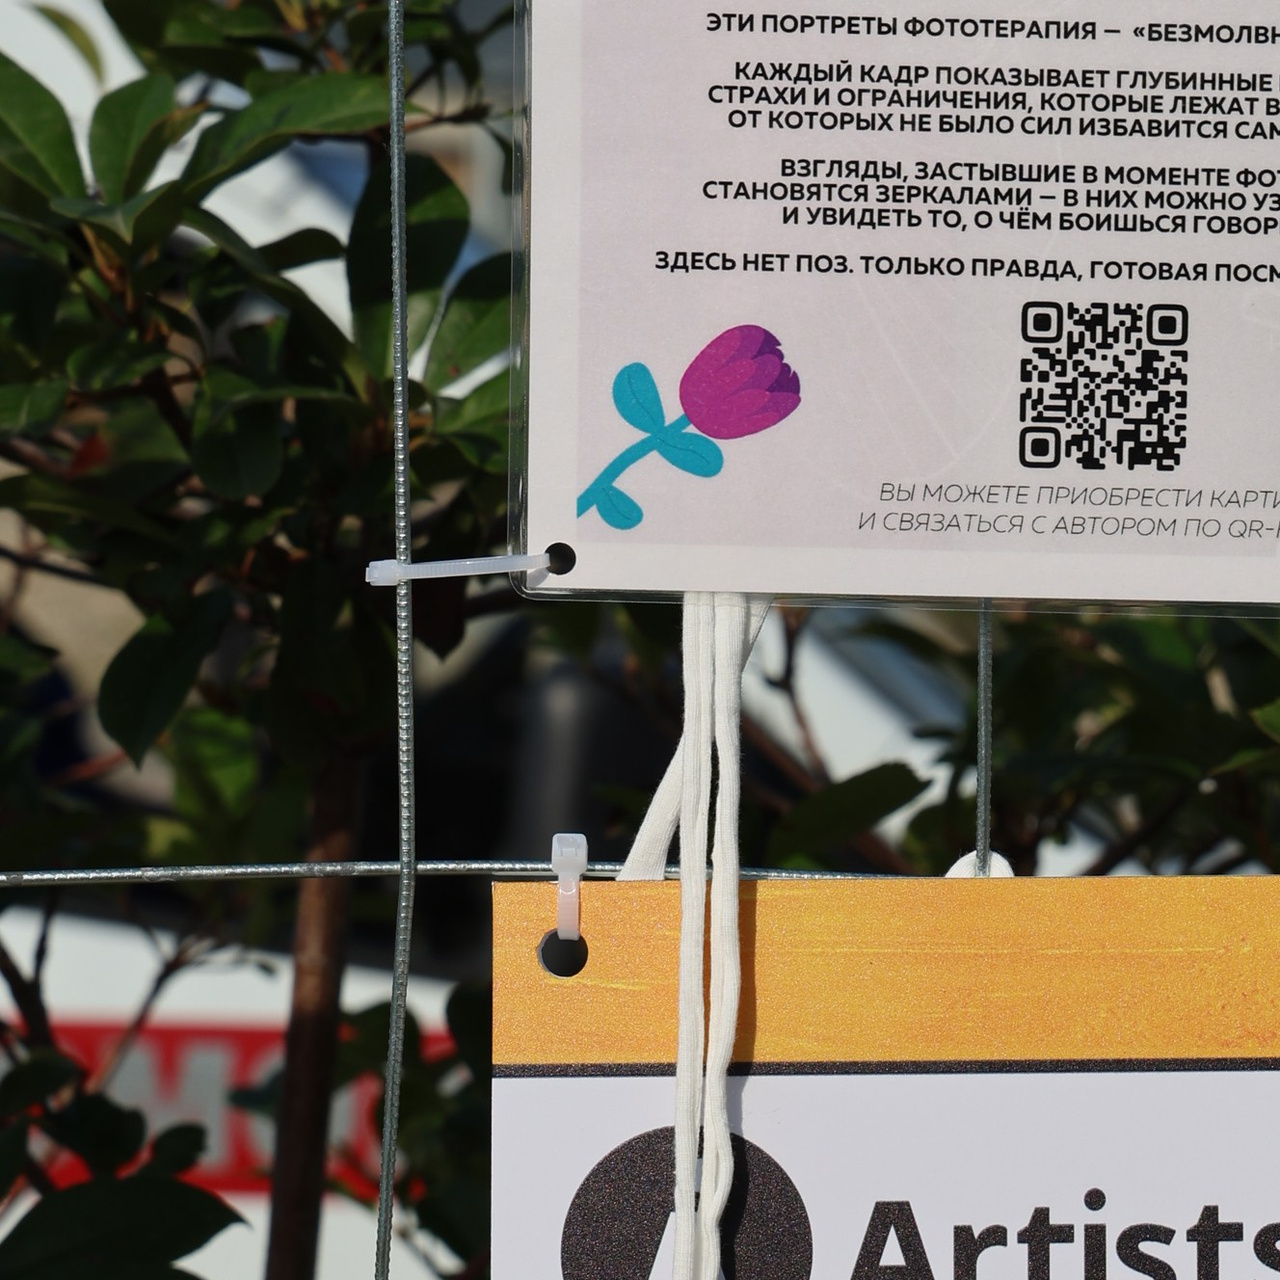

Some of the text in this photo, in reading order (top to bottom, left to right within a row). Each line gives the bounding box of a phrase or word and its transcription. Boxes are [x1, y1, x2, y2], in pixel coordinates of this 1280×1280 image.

[706, 12, 755, 32] ЭТИ
[761, 14, 897, 36] ПОРТРЕТЫ
[904, 16, 1097, 40] ФОТОТЕРАПИЯ
[735, 61, 853, 85] КАЖДЫЙ
[860, 64, 929, 87] КАДР
[935, 66, 1111, 88] ПОКАЗЫВАЕТ
[1116, 70, 1273, 92] ГЛУБИННЫЕ
[708, 84, 806, 106] СТРАХИ
[813, 87, 830, 106] И
[837, 87, 1033, 114] ОГРАНИЧЕНИЯ,
[1040, 92, 1164, 114] КОТОРЫЕ
[1169, 95, 1260, 116] ЛЕЖАТ
[1265, 97, 1280, 116] В
[728, 109, 762, 128] ОТ
[768, 110, 893, 132] КОТОРЫХ
[899, 113, 932, 133] НЕ
[938, 114, 1015, 134] БЫЛО
[1020, 115, 1072, 136] СИЛ
[1079, 117, 1228, 139] ИЗБАВИТСЯ
[781, 158, 908, 183] ВЗГЛЯДЫ,
[914, 161, 1076, 184] ЗАСТЫВШИЕ
[1082, 165, 1098, 184] В
[1104, 165, 1230, 187] МОМЕНТЕ
[702, 180, 869, 203] СТАНОВЯТСЯ
[875, 184, 1032, 206] ЗЕРКАЛАМИ
[1063, 188, 1079, 207] В
[1085, 189, 1138, 209] НИХ
[1144, 190, 1247, 211] МОЖНО
[782, 206, 799, 225] И
[806, 206, 922, 230] УВИДЕТЬ
[927, 209, 967, 232] ТО,
[974, 210, 993, 229] О
[999, 206, 1052, 230] ЧЁМ
[1059, 212, 1186, 233] БОИШЬСЯ
[655, 250, 737, 273] ЗДЕСЬ
[742, 253, 790, 272] НЕТ
[796, 254, 854, 274] ПОЗ.
[859, 255, 965, 276] ТОЛЬКО
[971, 258, 1083, 282] ПРАВДА,
[1090, 260, 1208, 282] ГОТОВАЯ
[879, 481, 917, 503] ВЫ
[921, 483, 1031, 505] МОЖЕТЕ
[1036, 485, 1204, 508] ПРИОБРЕСТИ
[857, 511, 877, 531] И
[882, 511, 1025, 534] СВЯЗАТЬСЯ
[1030, 514, 1047, 535] С
[1051, 515, 1178, 537] АВТОРОМ
[1183, 517, 1222, 539] ПО
